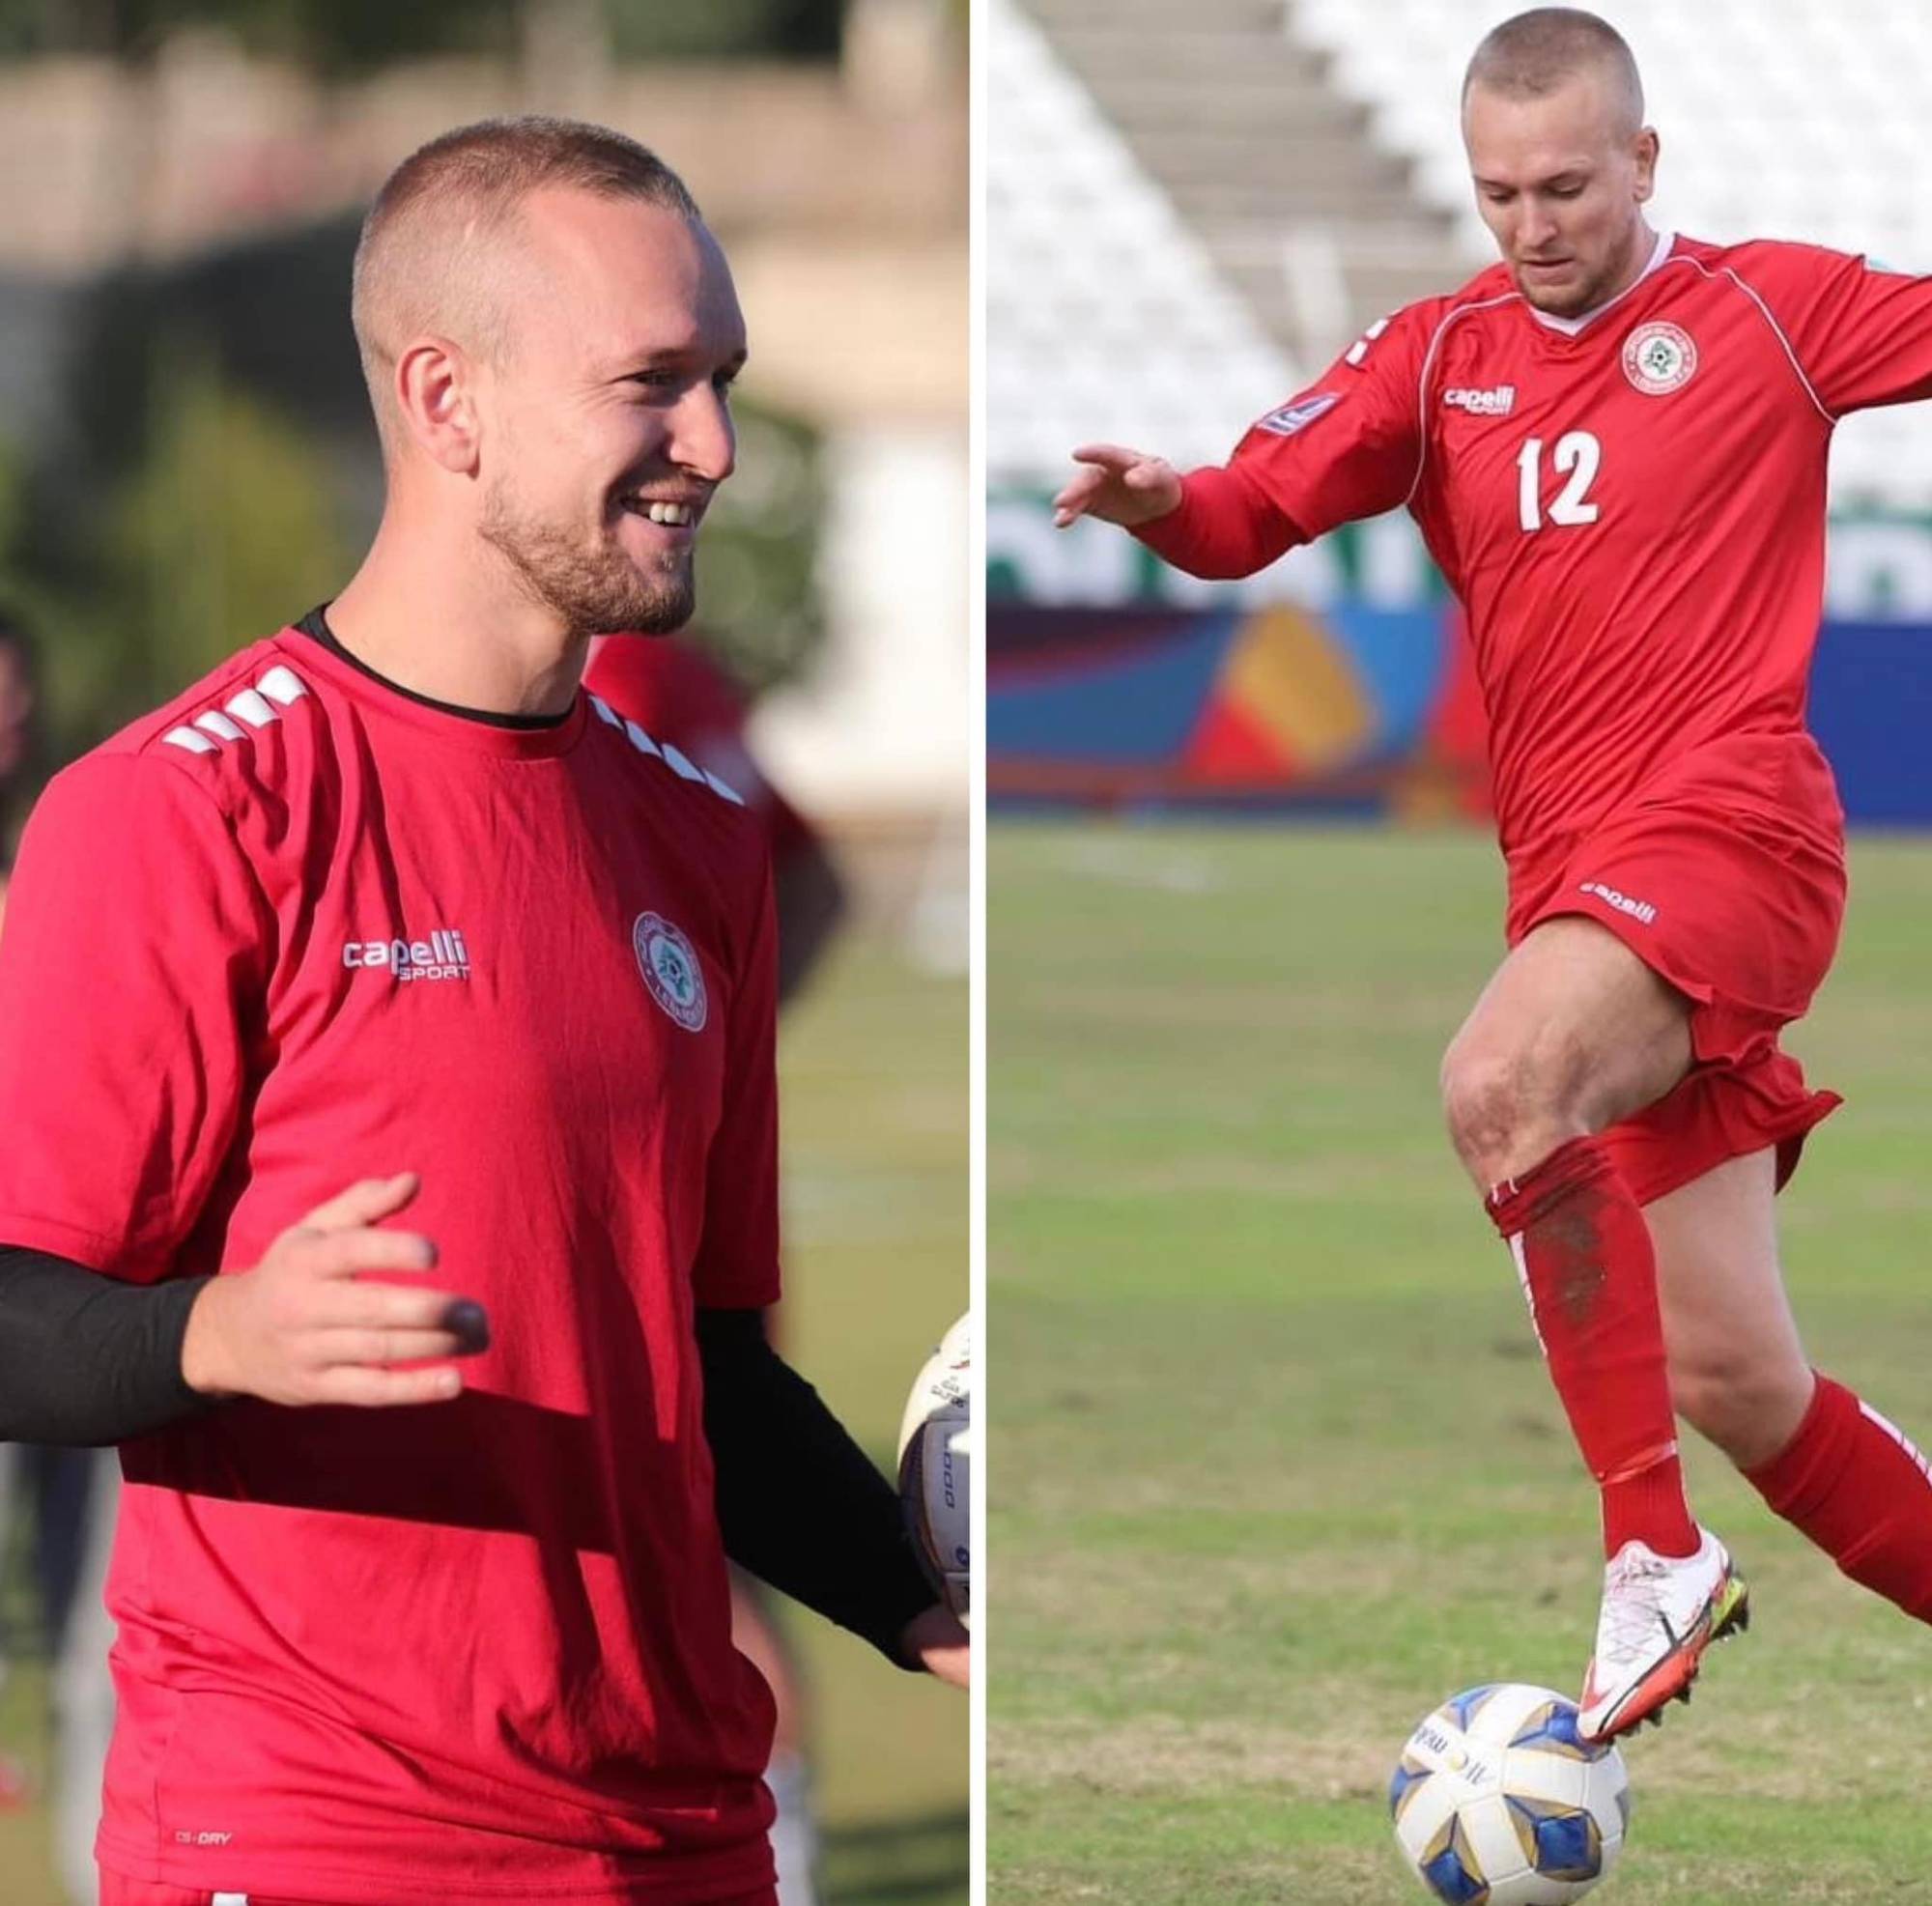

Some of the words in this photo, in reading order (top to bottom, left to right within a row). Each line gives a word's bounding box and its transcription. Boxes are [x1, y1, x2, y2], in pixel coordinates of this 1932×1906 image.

[1516, 431, 1601, 531] 12
[343, 930, 467, 975] capelli
[399, 966, 470, 981] SPORT
